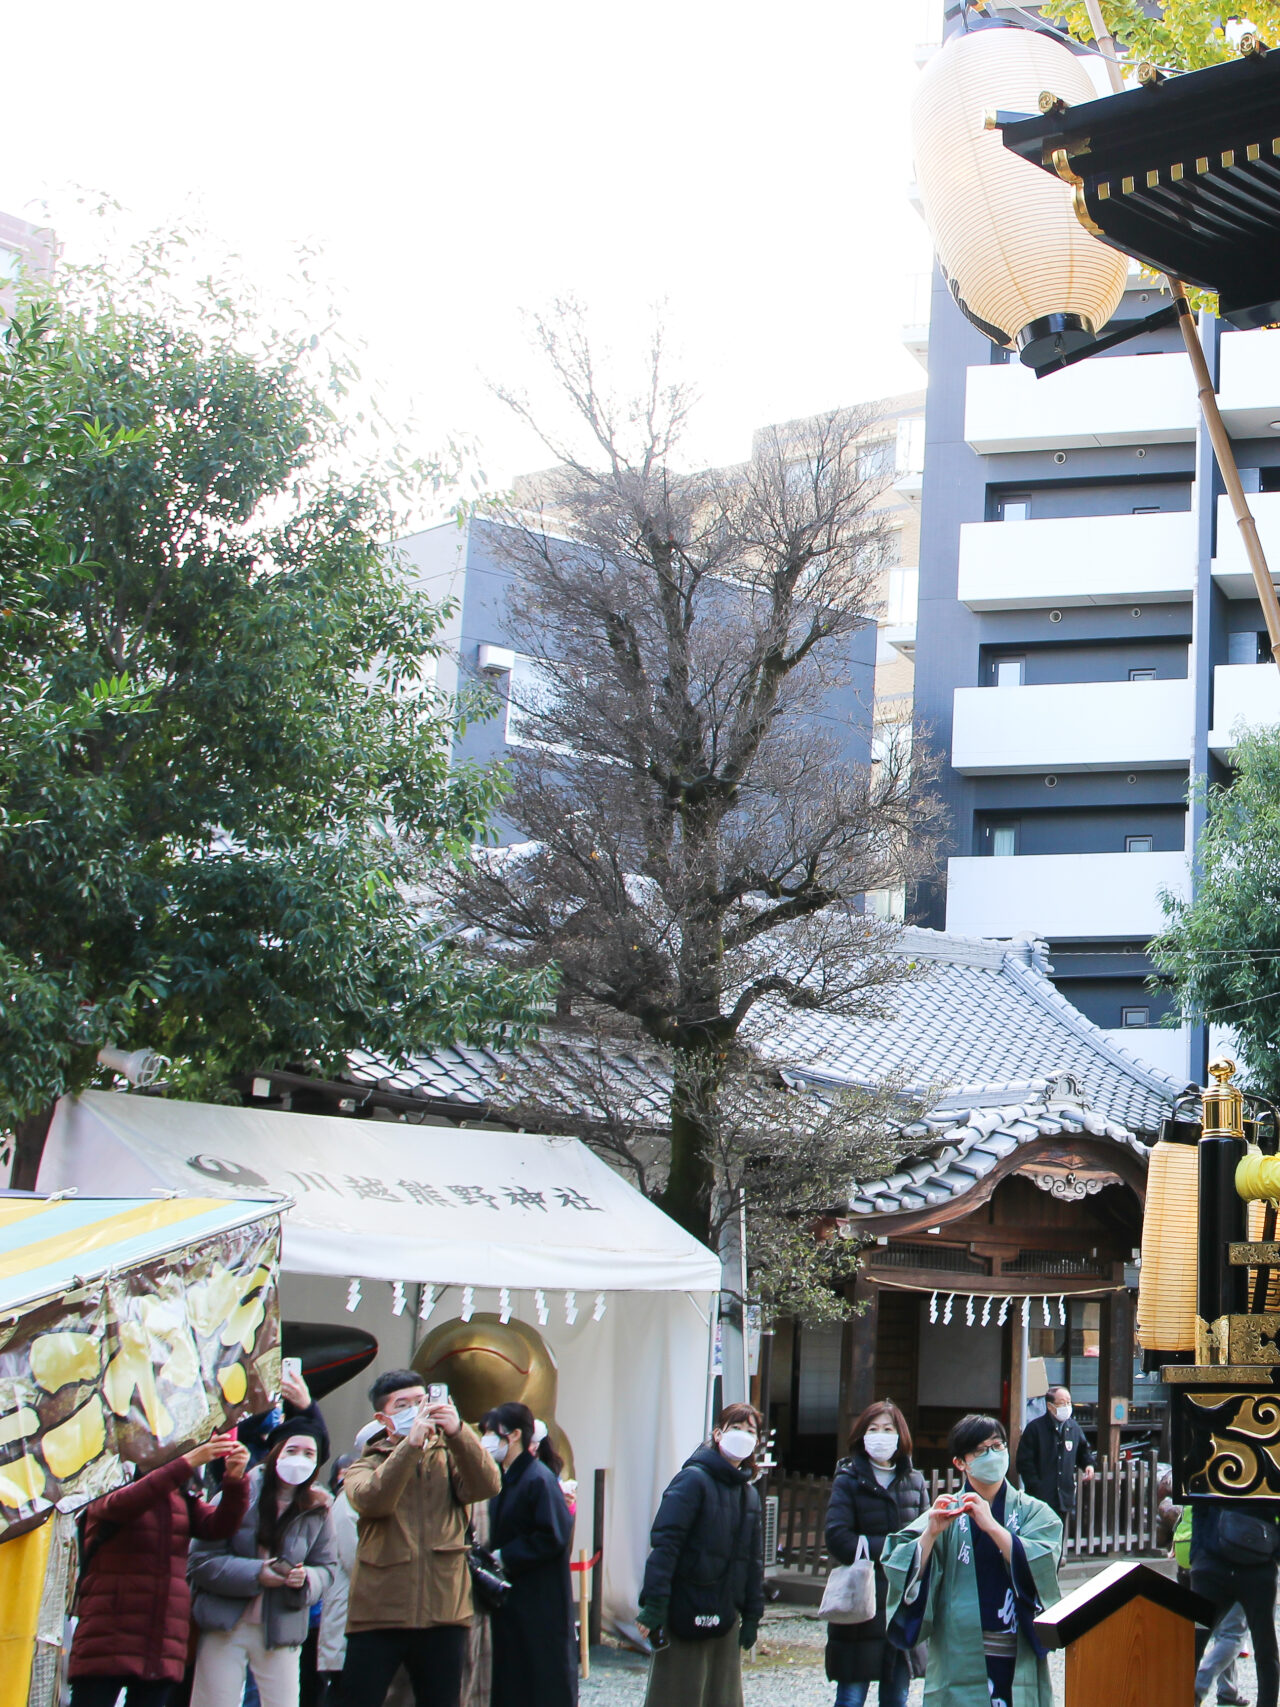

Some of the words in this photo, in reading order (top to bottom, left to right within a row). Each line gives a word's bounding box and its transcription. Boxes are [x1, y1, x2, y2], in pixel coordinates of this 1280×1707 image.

[290, 1171, 604, 1212] 川越熊野神社
